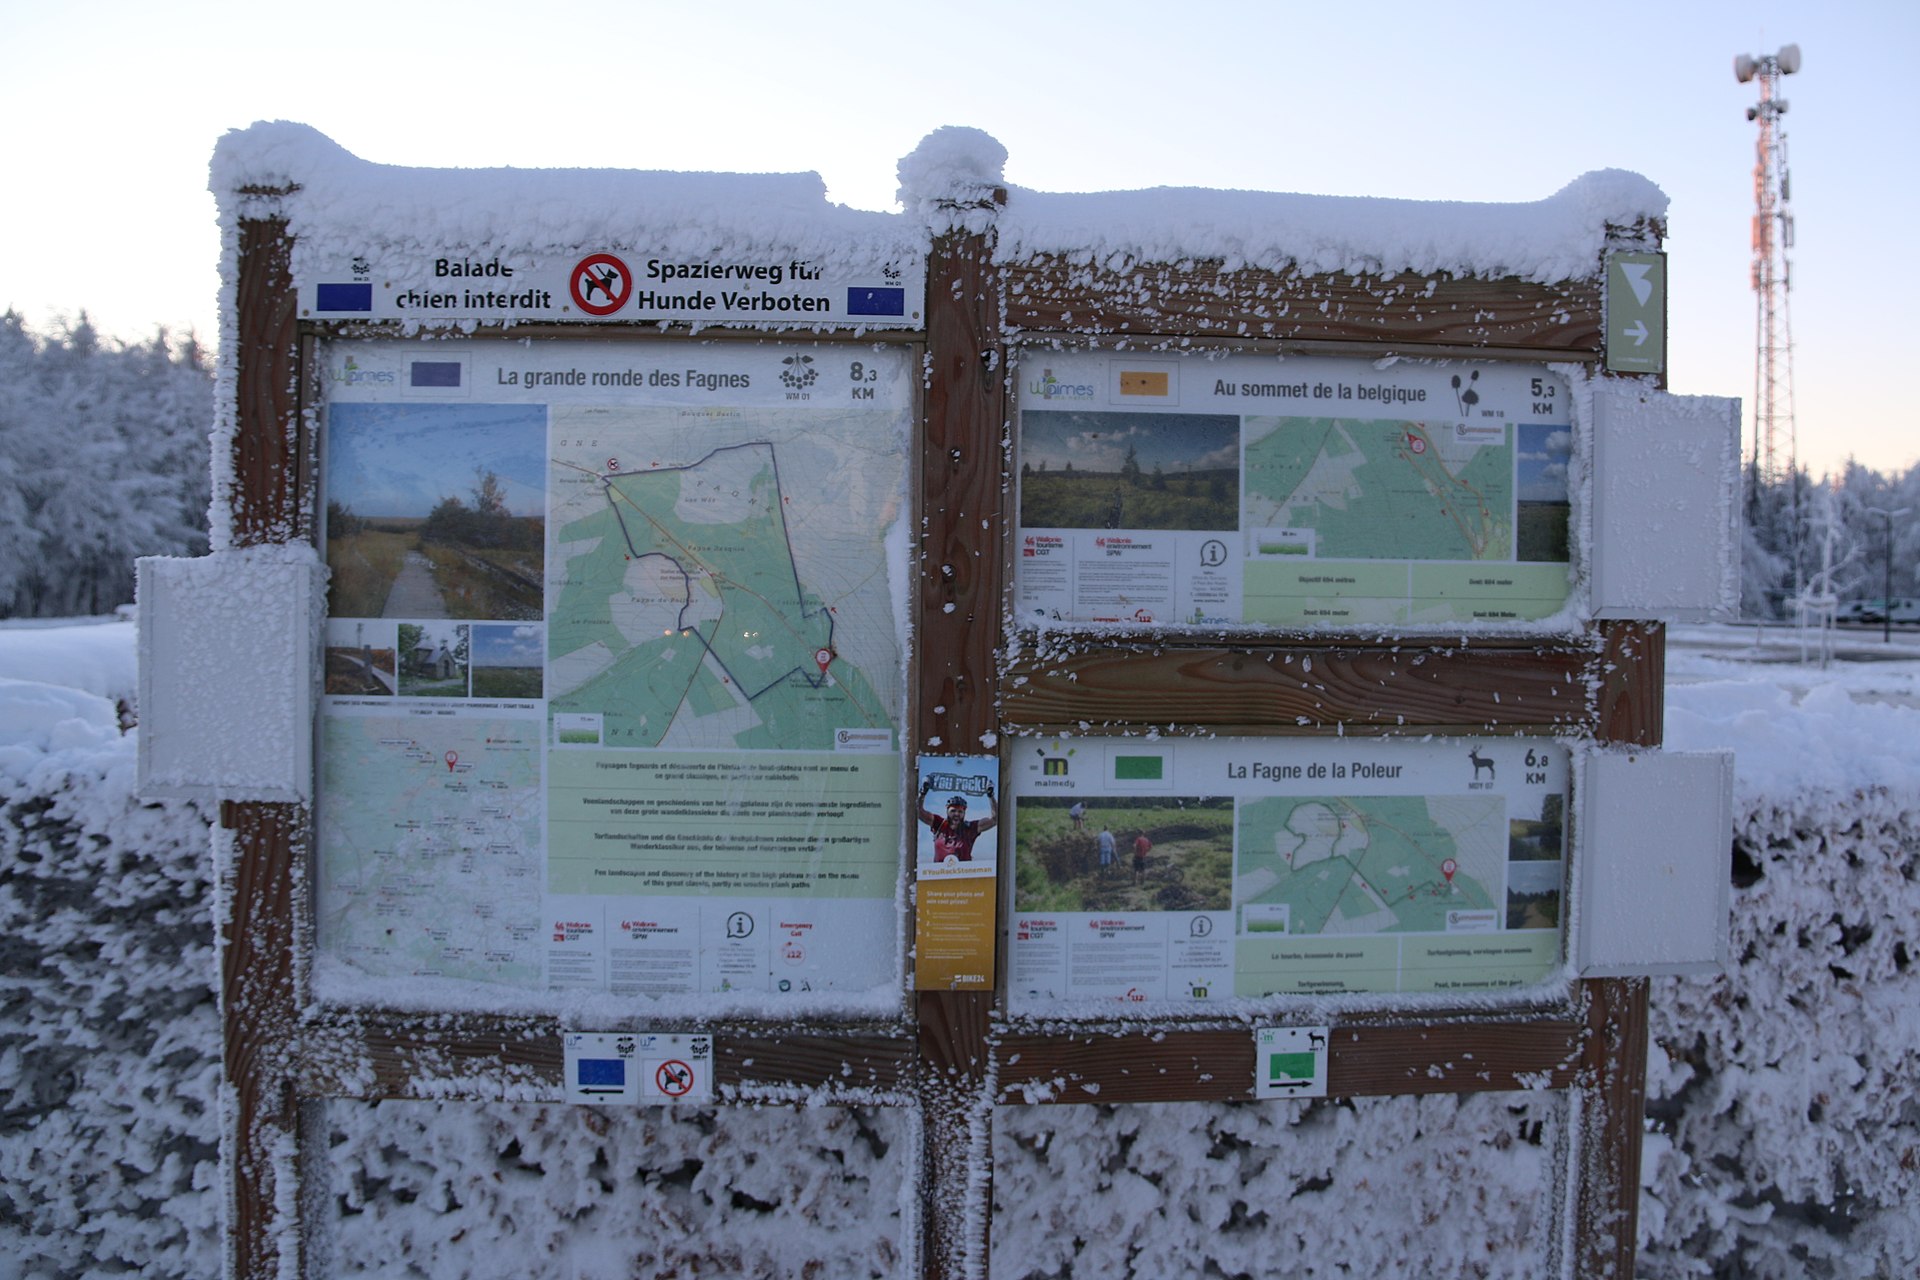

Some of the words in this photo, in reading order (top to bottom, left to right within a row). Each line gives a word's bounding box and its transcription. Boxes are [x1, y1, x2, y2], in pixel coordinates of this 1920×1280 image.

[647, 259, 783, 284] Spazierweg
[789, 261, 824, 280] für
[396, 289, 457, 309] chien
[465, 290, 551, 309] interdit
[639, 290, 716, 310] Hunde
[721, 291, 830, 312] Verboten
[498, 368, 518, 385] La
[524, 368, 586, 389] grande
[592, 370, 642, 387] ronde
[648, 370, 680, 388] des
[686, 370, 750, 391] Fagnes
[850, 362, 877, 383] 8,3
[786, 392, 799, 400] WM
[802, 392, 810, 400] 01
[852, 388, 875, 400] KM
[1214, 379, 1236, 397] Au
[1241, 381, 1309, 399] sommet
[1313, 382, 1333, 399] de
[1338, 383, 1352, 400] la
[1358, 384, 1426, 404] belgique
[1530, 378, 1555, 399] 5,3
[1532, 402, 1553, 415] KM
[1036, 548, 1050, 556] CGT
[1524, 749, 1549, 768] 6,8
[1228, 762, 1247, 779] La
[1253, 763, 1302, 782] Fagne
[1307, 762, 1327, 779] de
[1332, 762, 1346, 779] la
[1352, 762, 1403, 779] Poleur
[1526, 773, 1546, 785] KM
[933, 775, 954, 790] You
[955, 776, 987, 792] rock!
[1034, 780, 1076, 788] malmedy
[594, 868, 606, 876] Fen
[922, 868, 992, 876] #YouRockStoneman
[780, 922, 813, 930] Emergency
